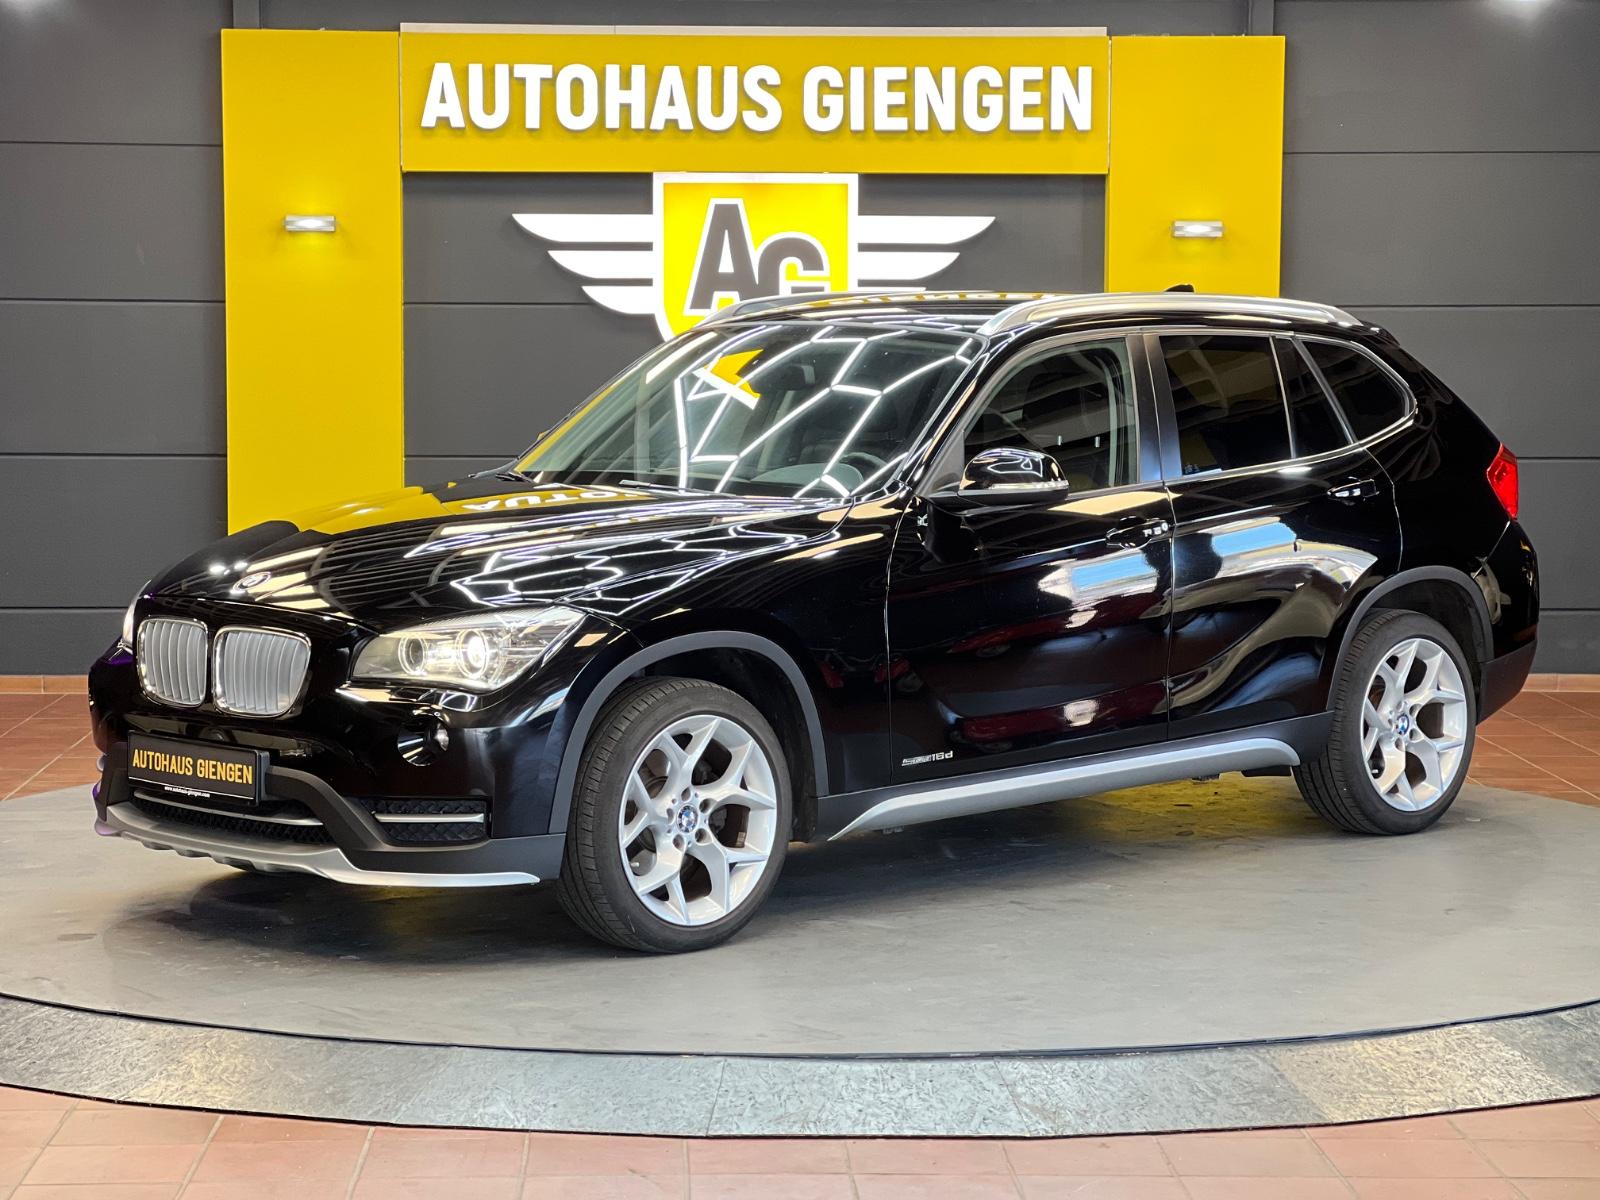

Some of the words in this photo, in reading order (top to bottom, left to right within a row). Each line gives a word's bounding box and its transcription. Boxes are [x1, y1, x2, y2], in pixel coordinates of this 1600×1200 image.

[421, 62, 782, 132] AUTOHAUS
[803, 65, 1092, 132] GIENGEN
[686, 200, 828, 312] AG
[132, 748, 194, 776] AUTOHAUS
[196, 758, 253, 785] GIENGEN
